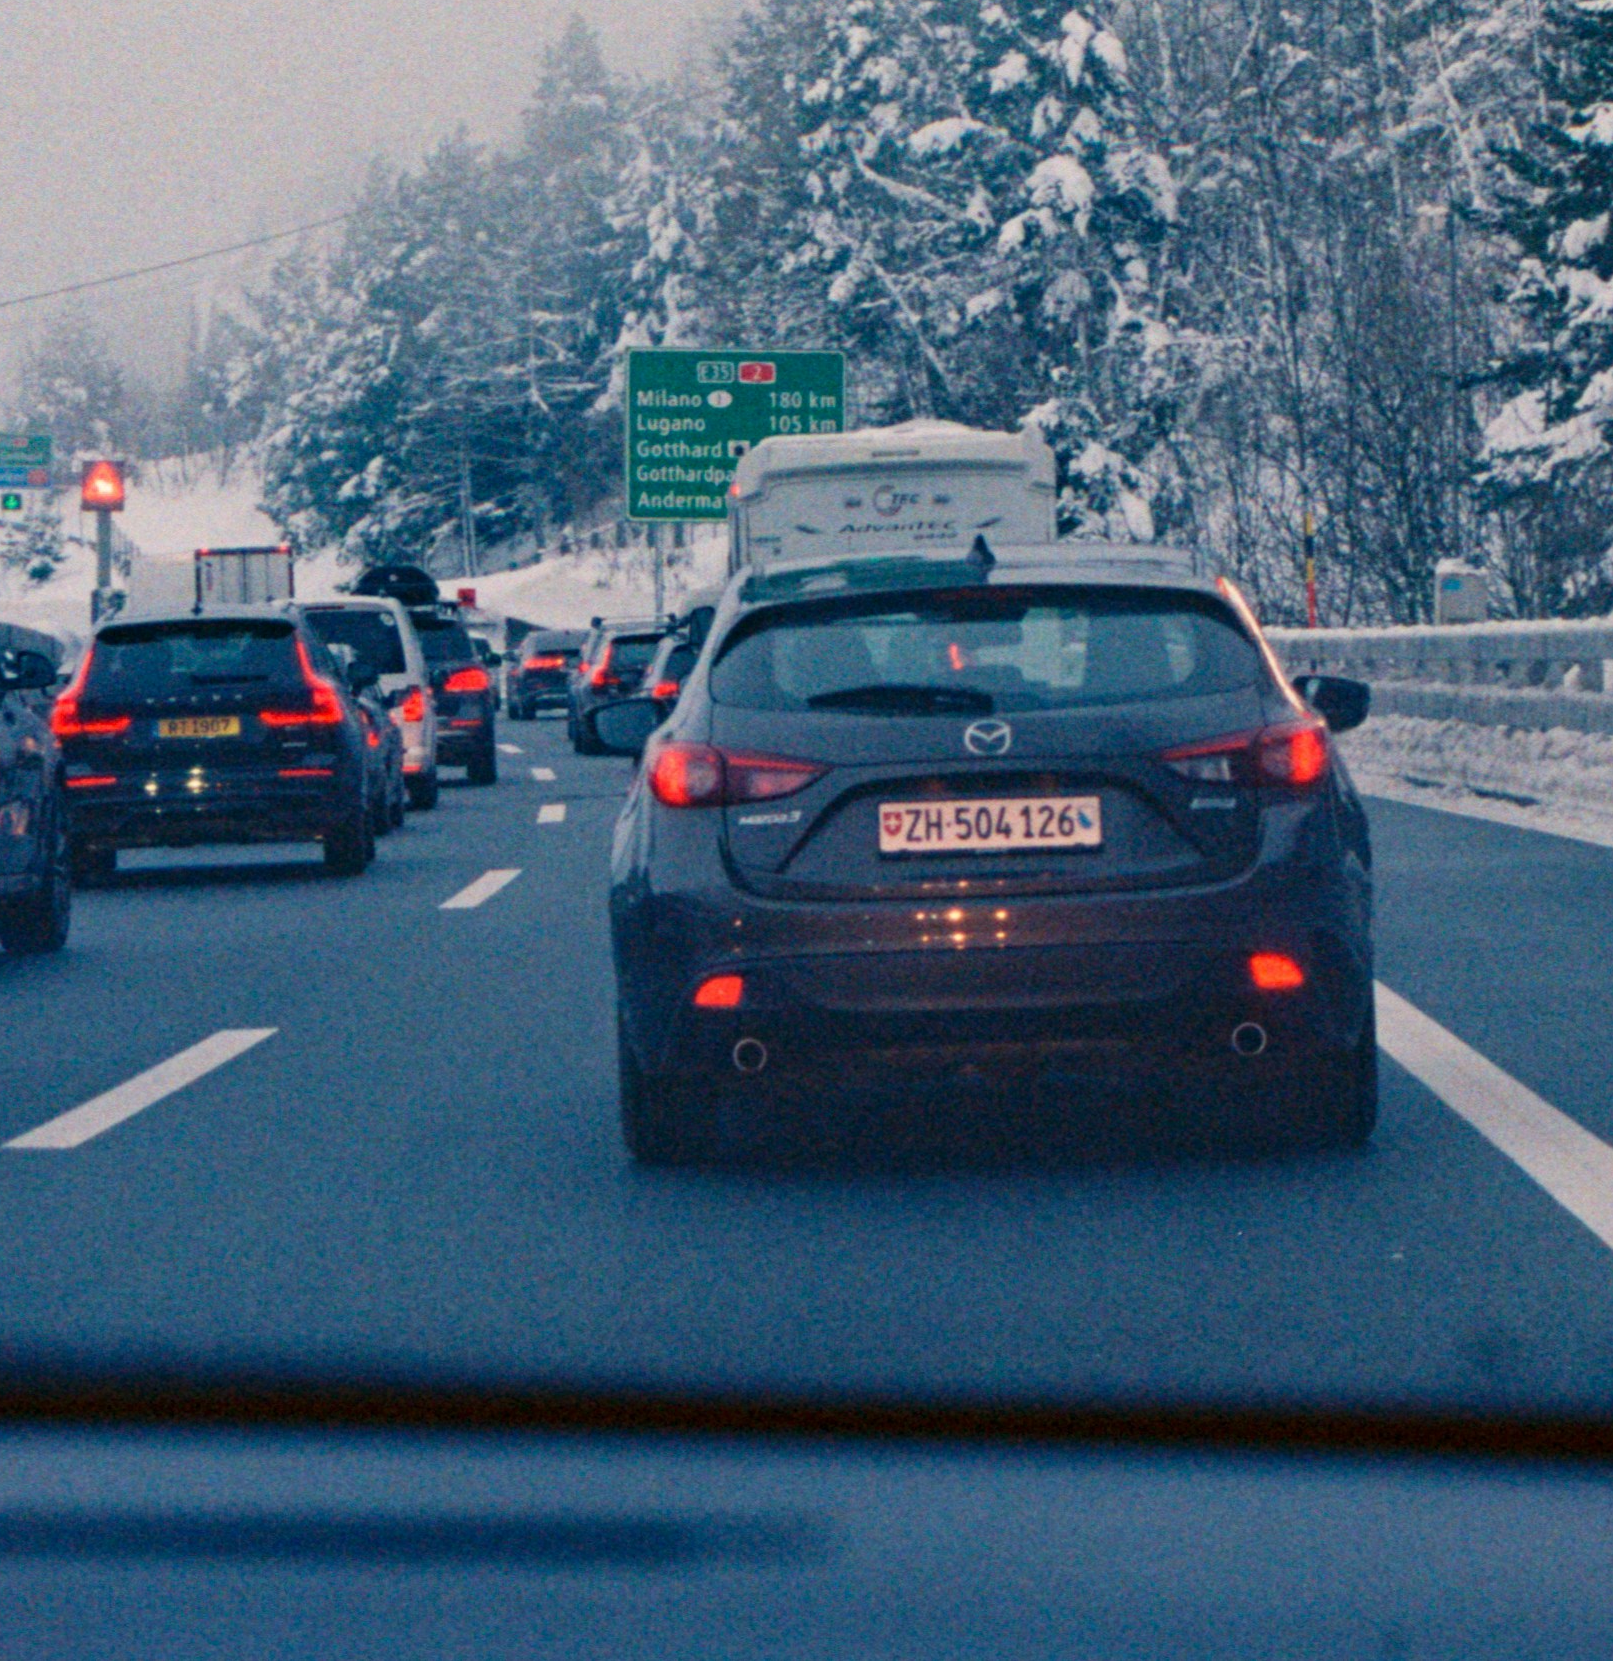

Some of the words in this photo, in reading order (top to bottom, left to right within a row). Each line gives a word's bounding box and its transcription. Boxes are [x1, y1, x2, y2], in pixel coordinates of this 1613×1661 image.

[753, 365, 762, 380] 2
[637, 390, 702, 408] Milano
[770, 391, 803, 408] 180
[809, 390, 836, 408] km
[637, 414, 706, 436] Lugano
[770, 415, 803, 433] 105
[809, 416, 836, 433] km
[637, 440, 722, 458] Gotthard
[638, 491, 728, 509] Anderma
